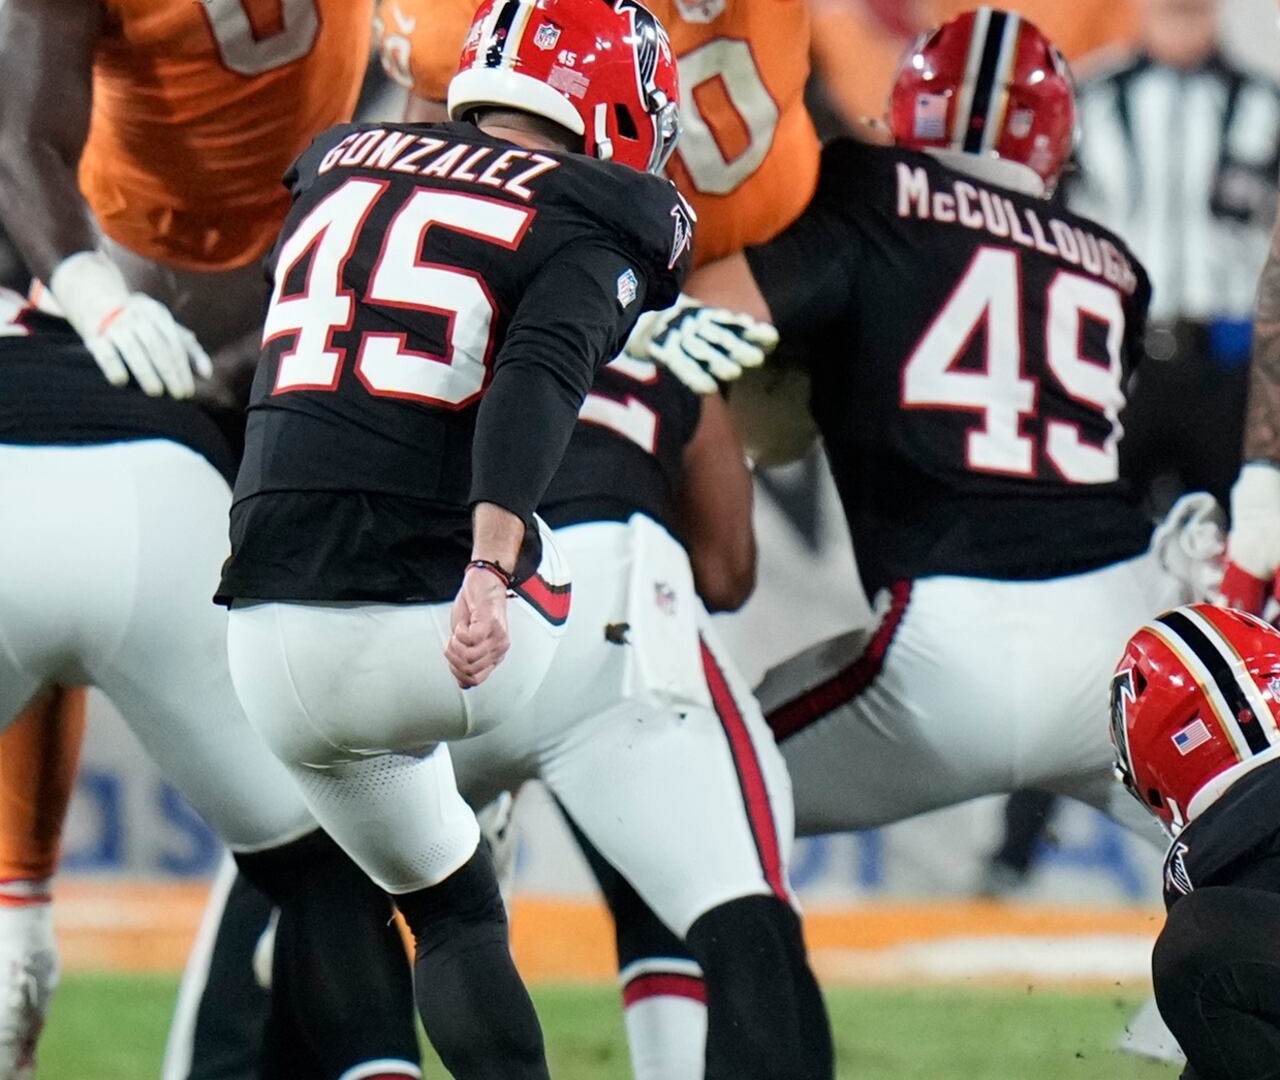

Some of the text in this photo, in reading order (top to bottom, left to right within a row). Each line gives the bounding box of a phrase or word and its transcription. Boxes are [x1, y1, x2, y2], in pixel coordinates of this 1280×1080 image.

[557, 49, 577, 67] 45
[318, 129, 560, 201] GONZALEZ
[261, 176, 537, 411] 45
[900, 245, 1126, 486] 49
